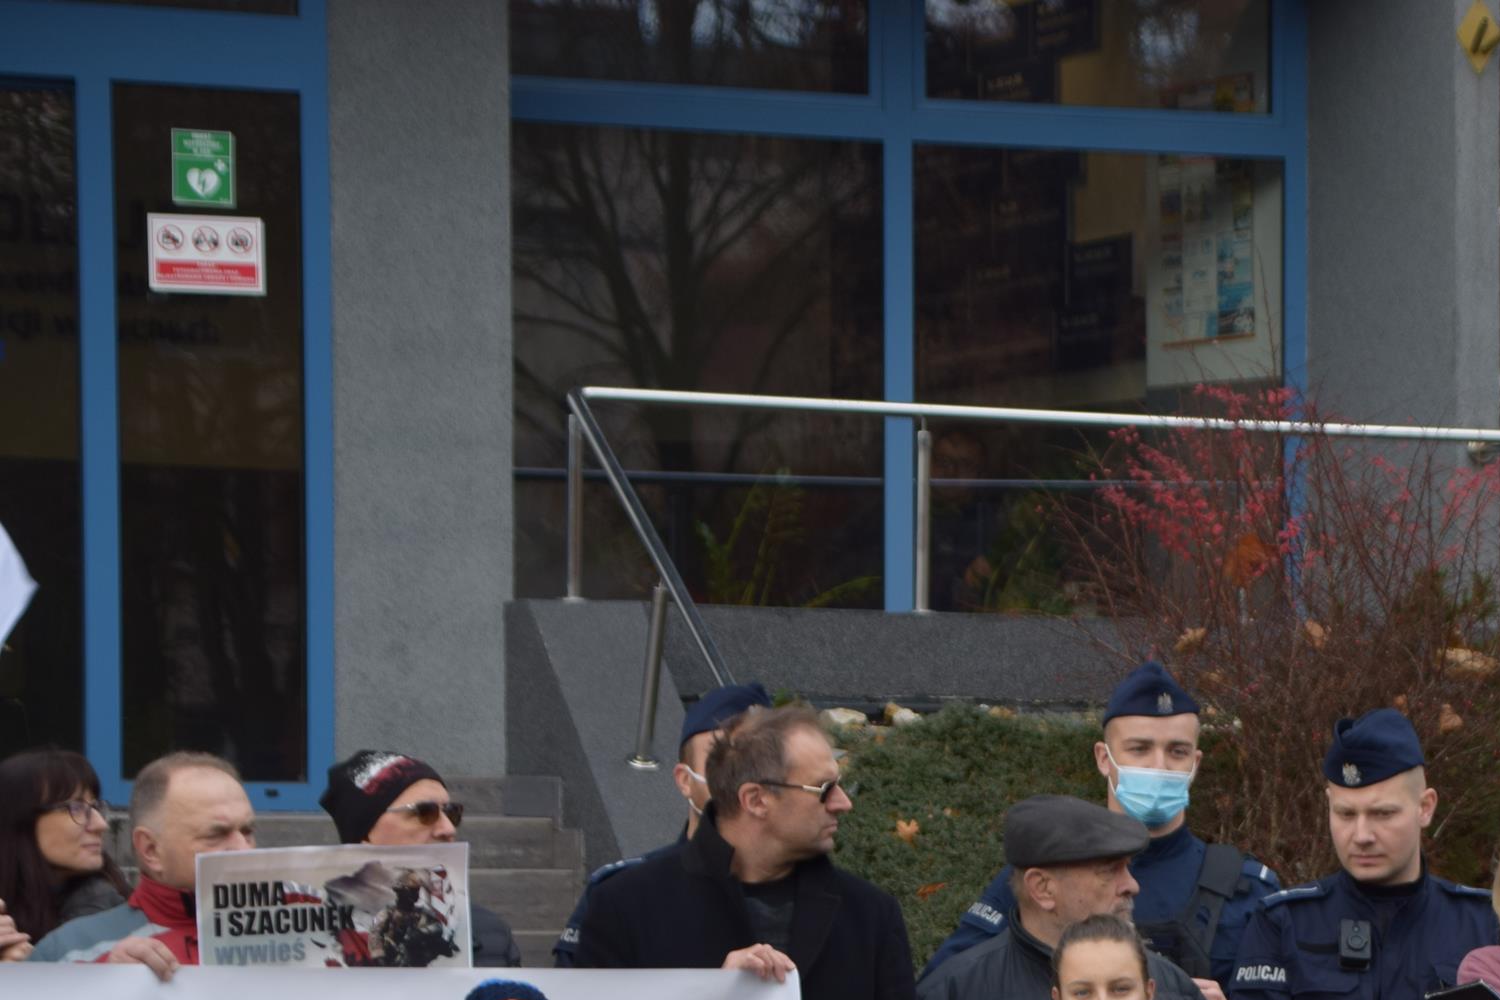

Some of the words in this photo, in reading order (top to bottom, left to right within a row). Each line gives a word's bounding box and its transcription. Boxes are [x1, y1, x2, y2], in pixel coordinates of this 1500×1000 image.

[212, 881, 285, 909] DUMA
[213, 911, 222, 937] i
[228, 904, 356, 935] SZACUNEK
[1236, 964, 1286, 983] POLICJA
